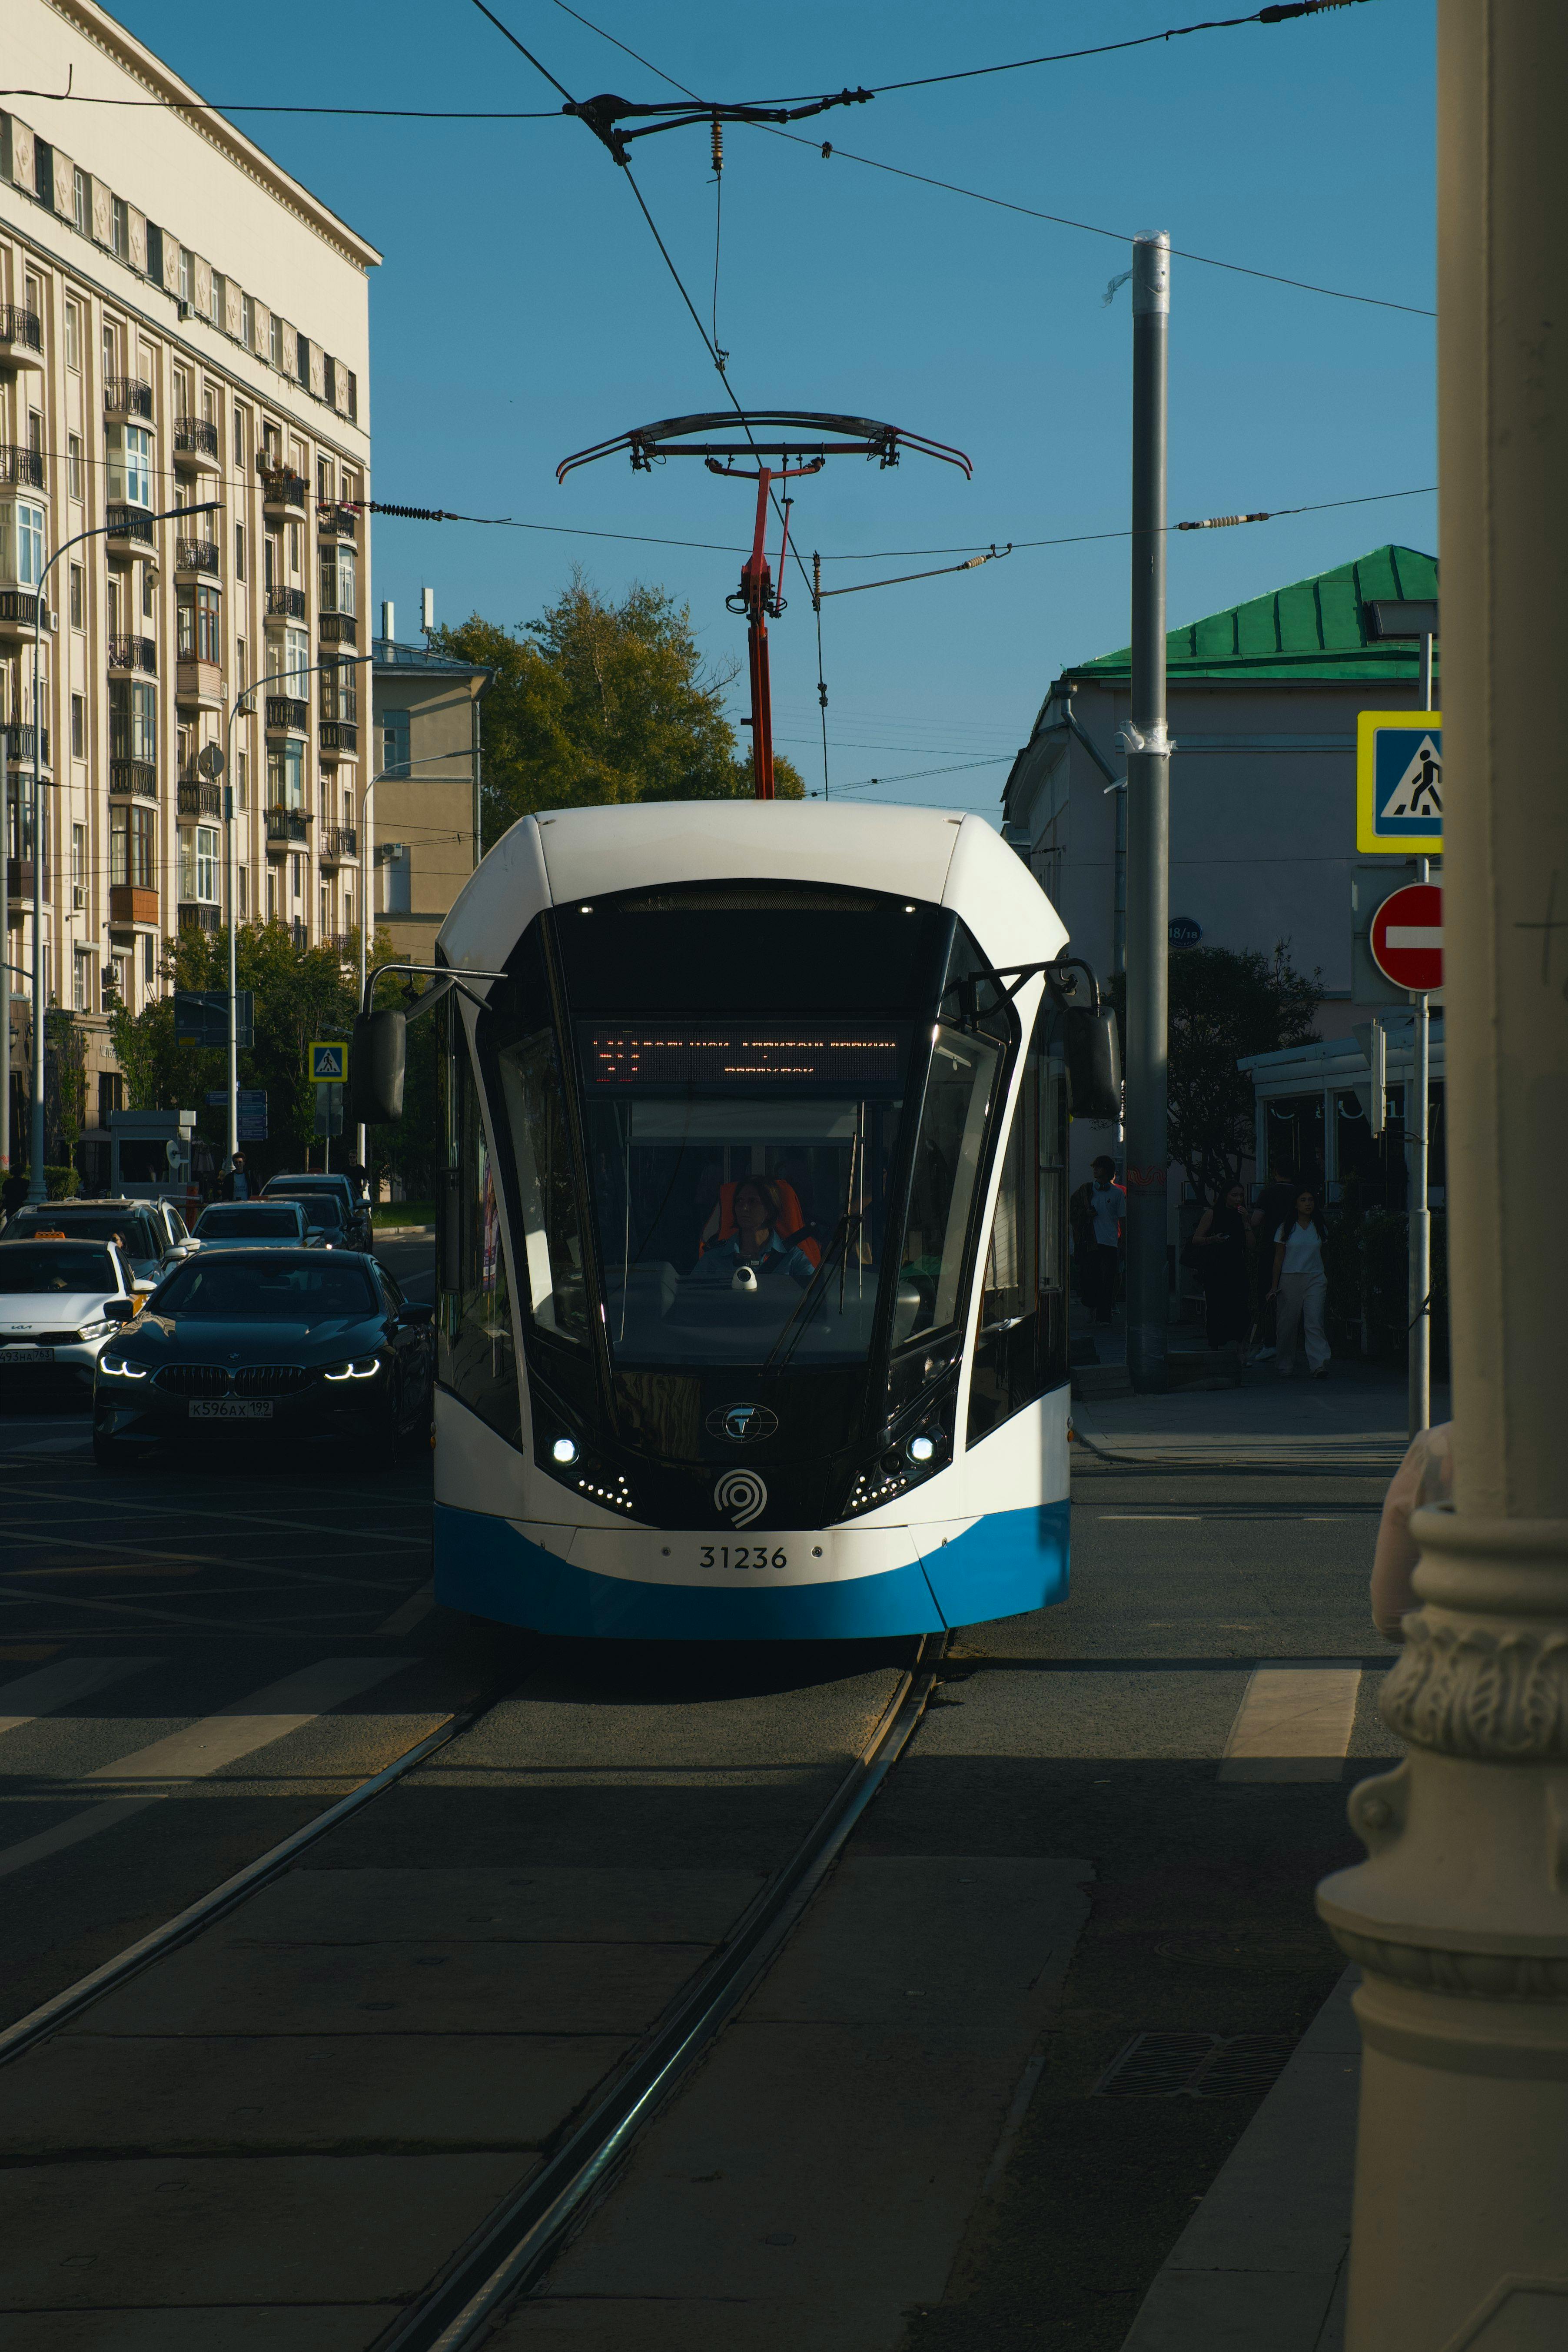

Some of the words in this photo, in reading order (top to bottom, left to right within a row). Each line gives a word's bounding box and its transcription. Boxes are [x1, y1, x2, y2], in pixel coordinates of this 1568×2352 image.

[1169, 927, 1198, 939] 18/18
[34, 1350, 50, 1358] 763
[193, 1402, 246, 1415] К596АХ
[249, 1402, 269, 1412] 199
[700, 1546, 787, 1569] 31236
